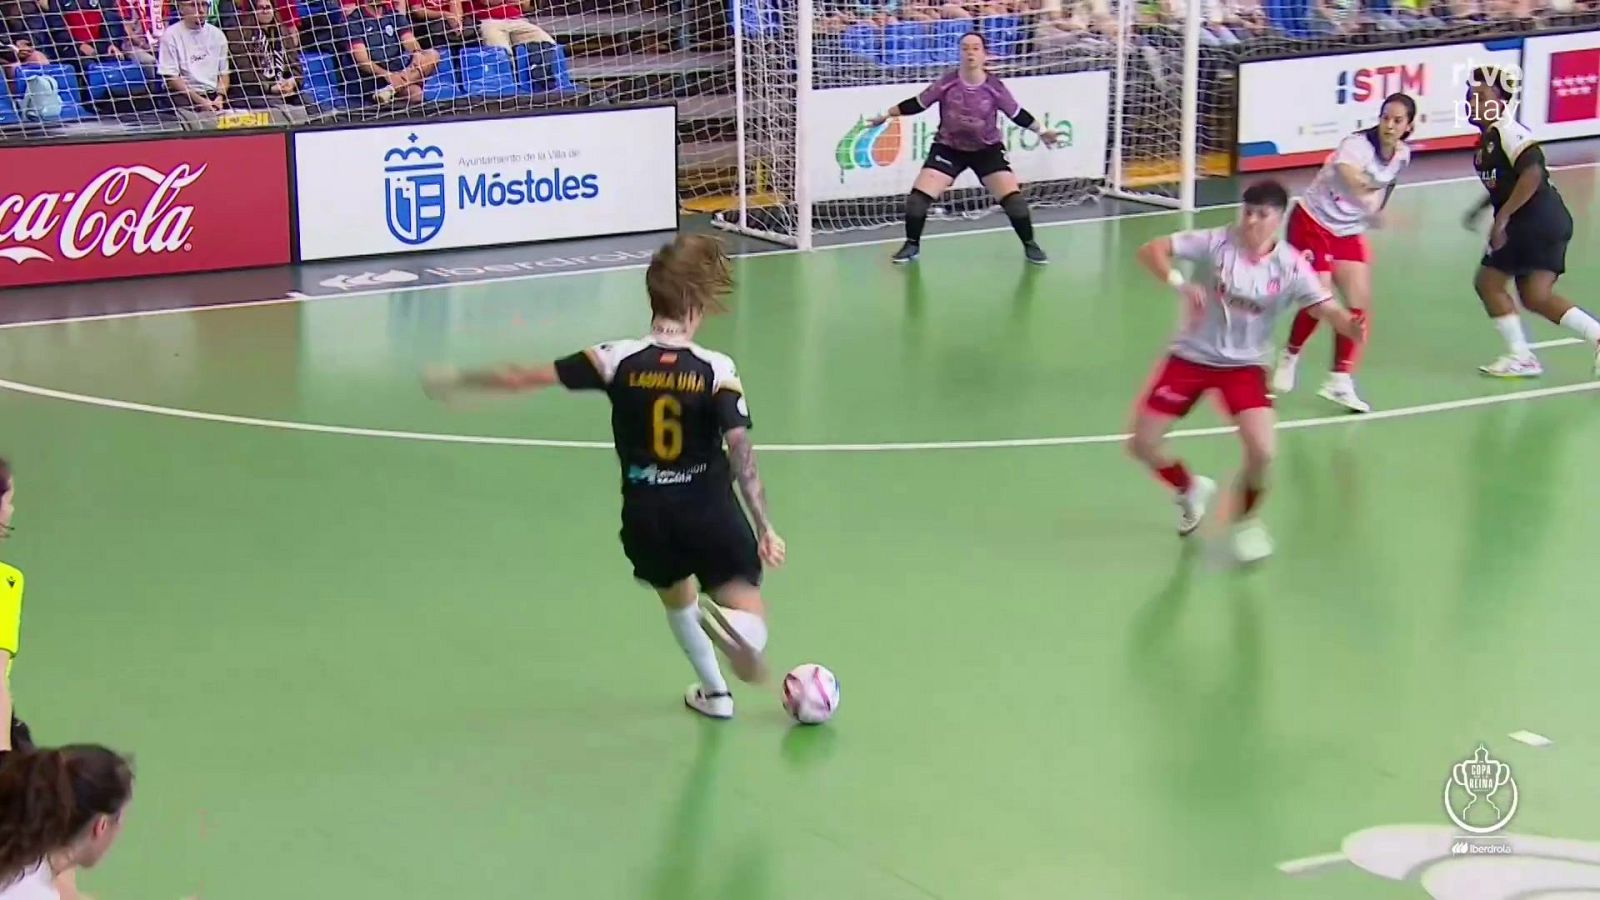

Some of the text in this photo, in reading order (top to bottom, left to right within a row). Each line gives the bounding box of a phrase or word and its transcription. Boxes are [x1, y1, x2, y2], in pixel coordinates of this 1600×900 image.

[458, 153, 521, 167] Ayuntamiento
[523, 152, 537, 161] de
[537, 151, 547, 160] la
[549, 149, 567, 160] Villa
[458, 167, 600, 209] Móstoles
[653, 395, 683, 461] 6
